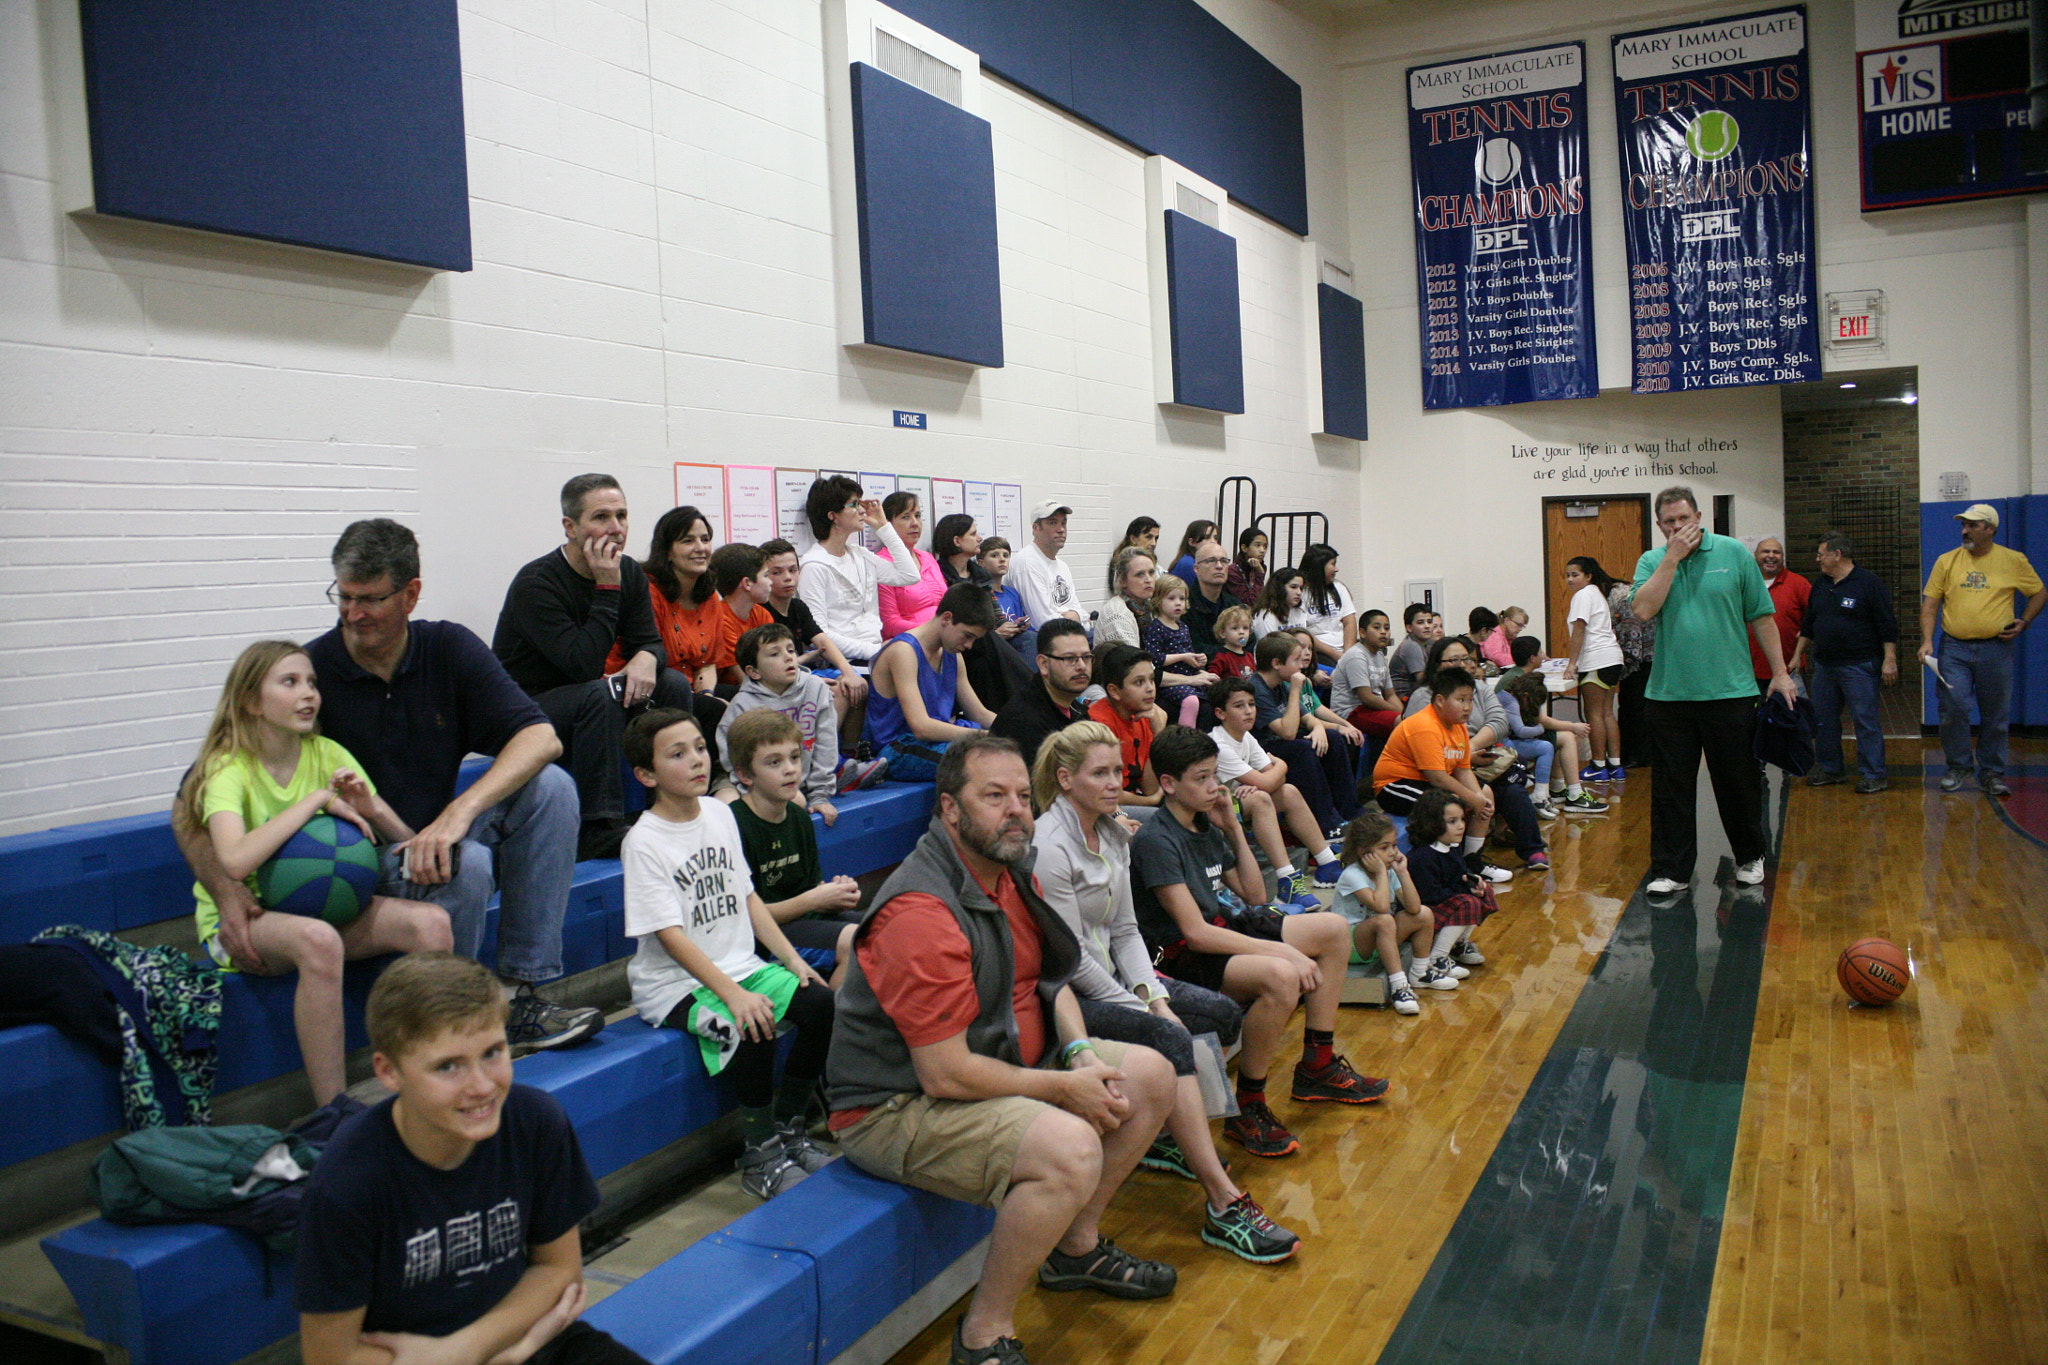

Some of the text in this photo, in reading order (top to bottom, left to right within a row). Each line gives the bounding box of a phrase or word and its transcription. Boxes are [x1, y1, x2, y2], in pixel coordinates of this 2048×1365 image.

[1904, 1, 2032, 35] MITSUBI
[1622, 17, 1797, 56] MARY IMMACULATE
[1417, 52, 1574, 88] MARY IMMACULATE
[1672, 47, 1747, 70] SCHOOL
[1462, 78, 1528, 98] SCHOOL
[1624, 64, 1800, 123] TENNIS
[1423, 92, 1573, 146] TENNIS
[1881, 107, 1951, 137] HOME
[2006, 110, 2032, 127] PE
[1628, 153, 1805, 210] CHAMPIONS
[1421, 172, 1583, 231] CHAMPIONS
[1682, 214, 1740, 238] DPL
[1476, 228, 1528, 250] DPL
[1428, 255, 1571, 277] 2012 Varsity Girls Doubles
[1632, 251, 1805, 279] 2006 J.V. Boys Rec. Sgls
[1428, 272, 1574, 294] 2012 J.V. Girls Rec. Singles
[1633, 282, 1669, 298] 2008
[1707, 280, 1738, 293] Boys
[1743, 275, 1772, 291] Sgls
[1428, 289, 1554, 310] 2012 J.V. Boys Doubles
[1634, 293, 1807, 318] 2008 V Boys Rec. Sgls
[1429, 305, 1574, 326] 2013 Varsity Girls Doubles
[1636, 315, 1808, 339] 2009 J.V. Boys Rec. Sgls
[1840, 316, 1869, 337] EXIT
[1430, 323, 1574, 343] 2013 J.V. Boys Rec. Singles
[1430, 336, 1574, 360] 2014 J.V. Boys Rec Singles
[1636, 337, 1777, 358] 2009 V Boys Dbls
[1431, 354, 1576, 376] 2014 Varsity Girls Doubles
[1637, 352, 1812, 376] 2010 J.V. Boys Comp. Sgls.
[1637, 368, 1805, 392] 2010 J.V. Girls Rec. Dbls.
[900, 413, 920, 426] HOME
[1512, 437, 1738, 462] Live your life in a way that others
[1533, 468, 1555, 479] are
[1562, 465, 1586, 481] glad
[1635, 464, 1647, 476] in
[1652, 462, 1673, 475] this
[673, 847, 735, 891] NATURAL
[695, 872, 725, 900] ORN
[692, 894, 738, 928] ALLER
